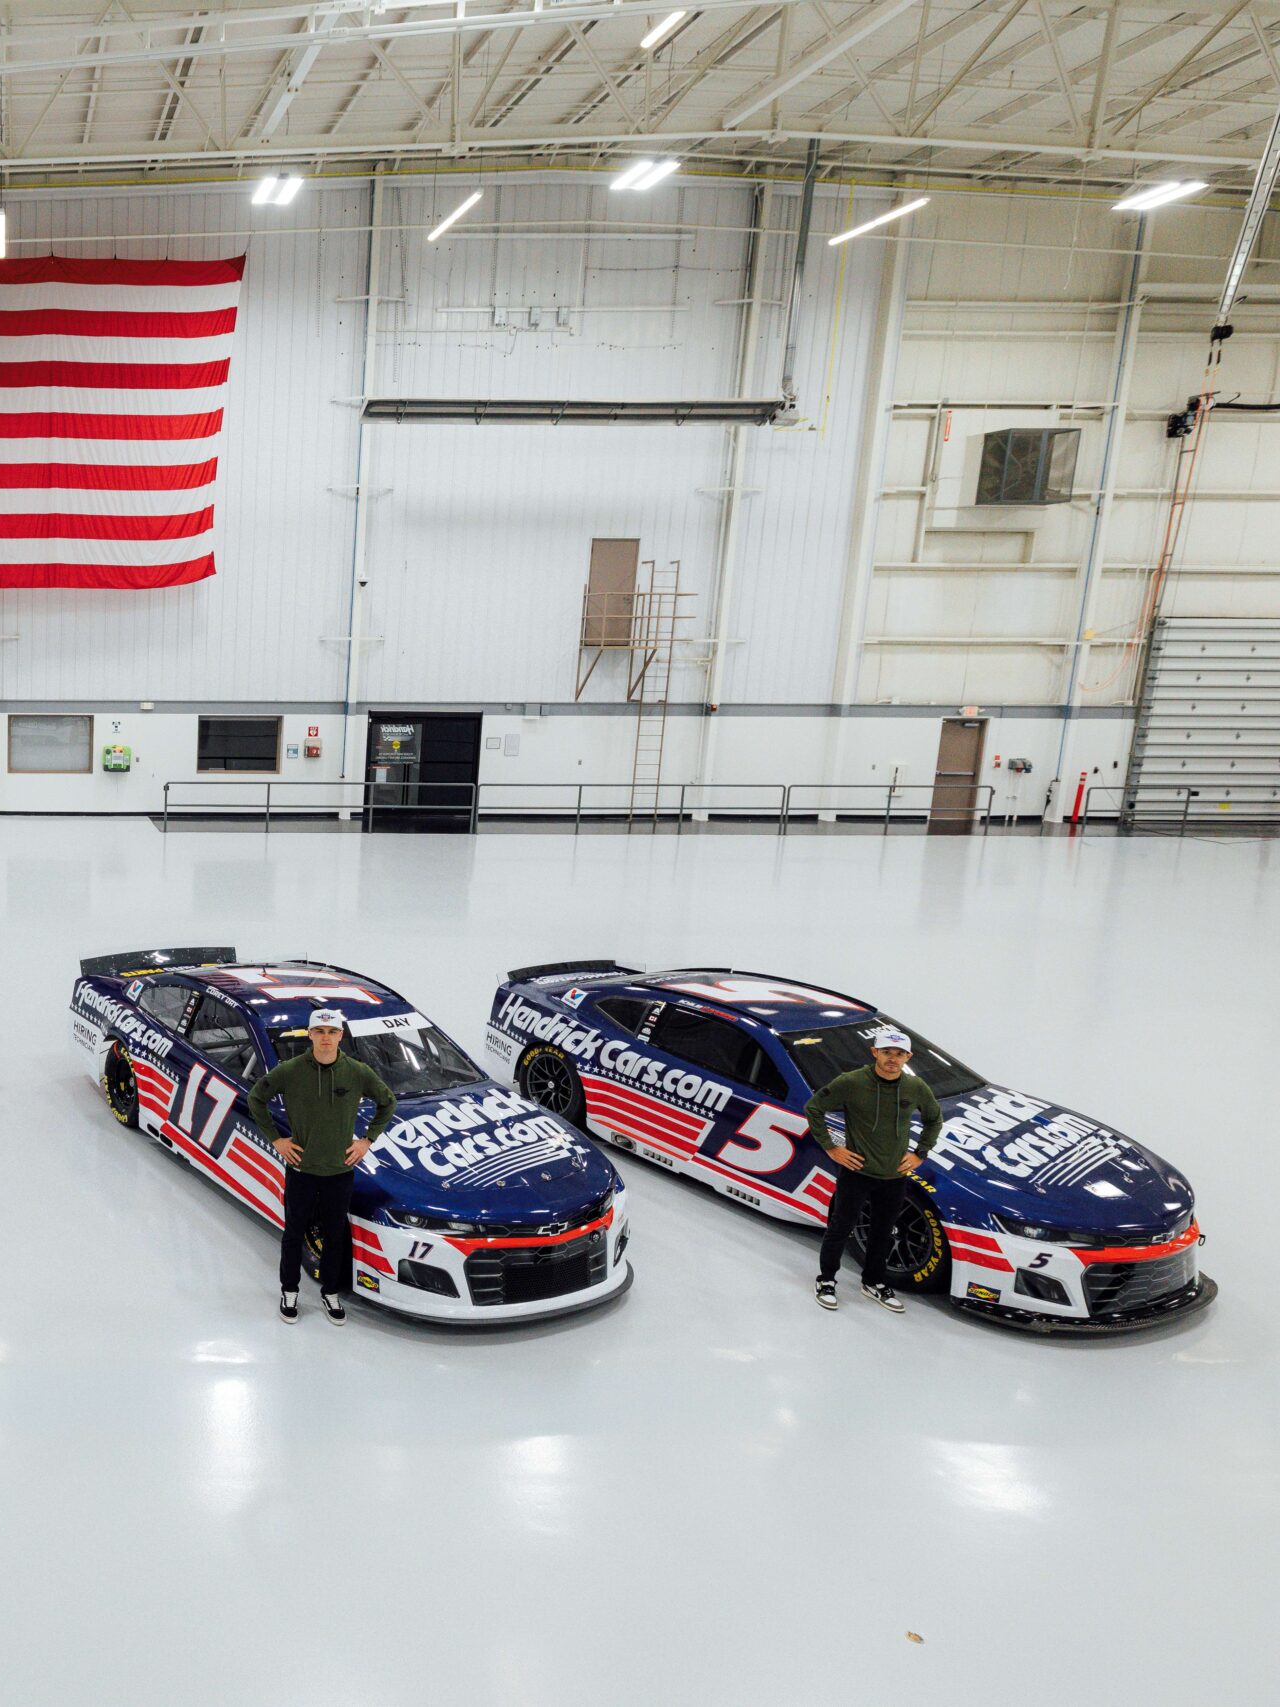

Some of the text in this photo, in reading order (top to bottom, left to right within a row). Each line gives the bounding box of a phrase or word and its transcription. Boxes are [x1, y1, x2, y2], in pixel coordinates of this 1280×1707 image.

[206, 986, 240, 1009] COREY DAY
[74, 1020, 97, 1046] HIRING
[384, 1017, 410, 1029] DAY
[486, 1031, 512, 1056] HIRING
[523, 1046, 565, 1066] GOODYEAR
[178, 1062, 239, 1151] 17
[418, 1115, 566, 1176] Cars.com
[717, 1101, 811, 1174] 5
[982, 1113, 1098, 1177] Cars.com
[906, 1171, 937, 1193] YEAR
[408, 1241, 434, 1260] 17
[914, 1210, 943, 1283] GOODYEAR
[1029, 1253, 1053, 1268] 5
